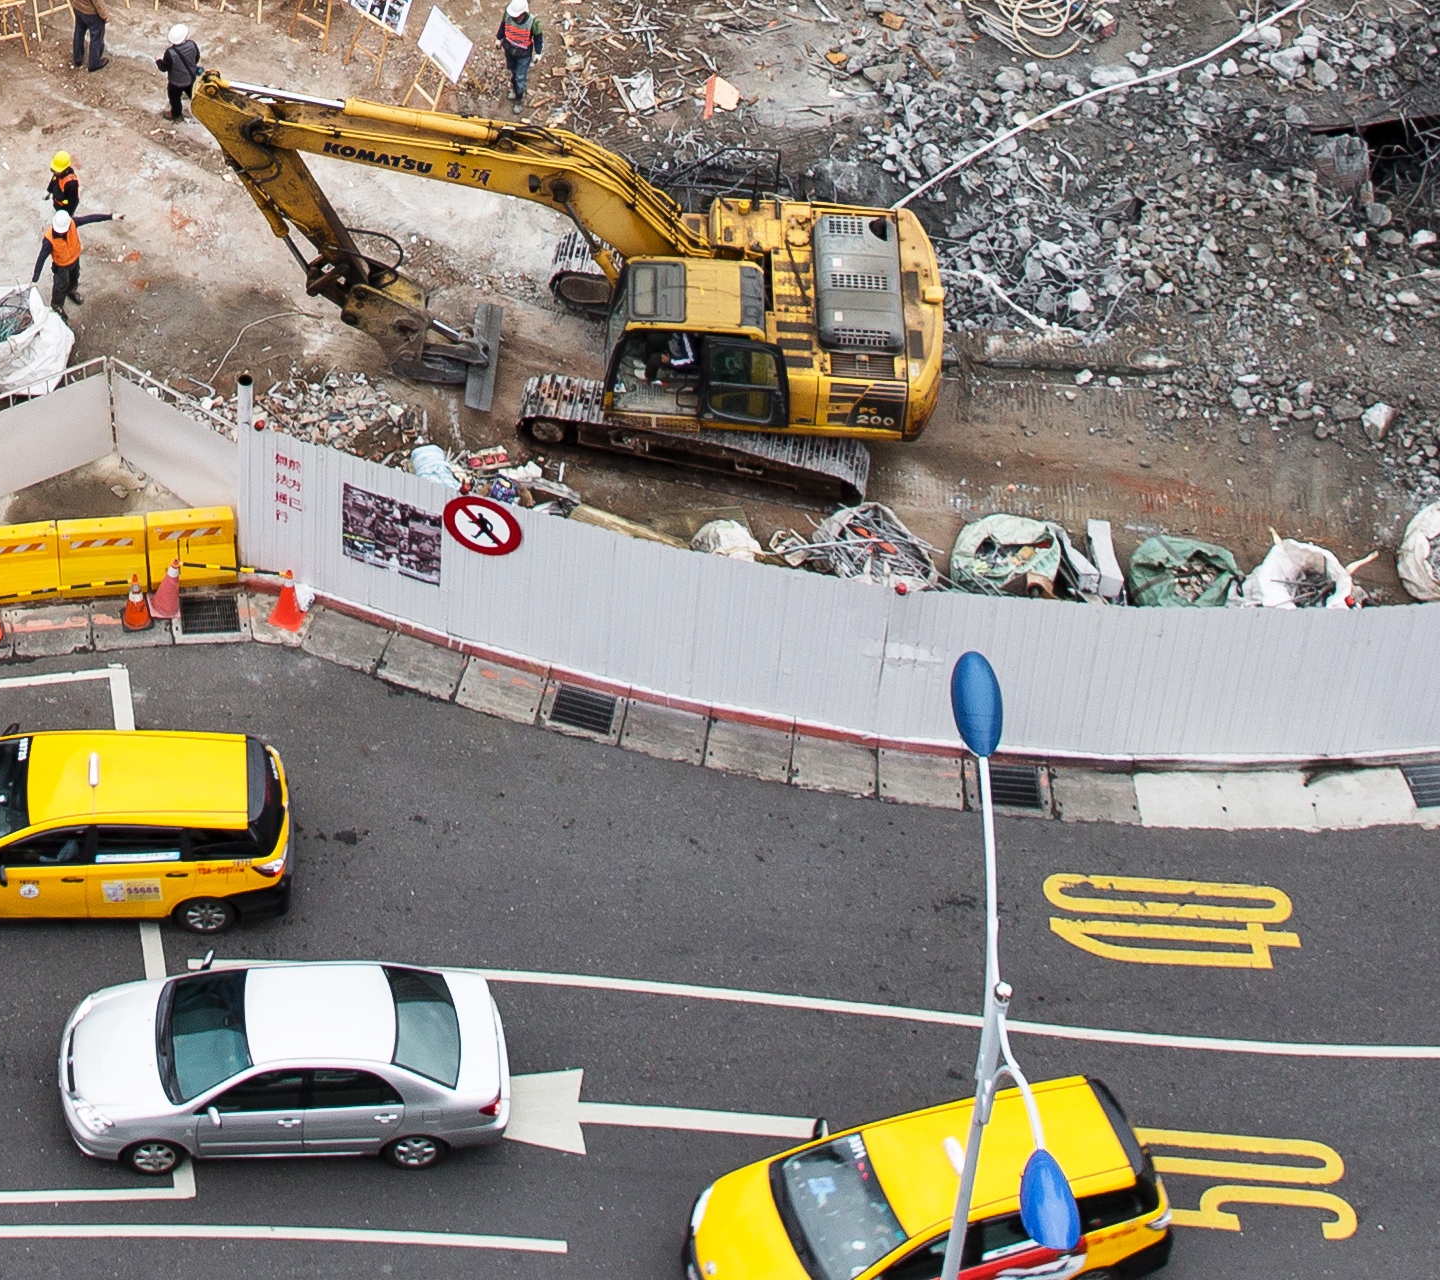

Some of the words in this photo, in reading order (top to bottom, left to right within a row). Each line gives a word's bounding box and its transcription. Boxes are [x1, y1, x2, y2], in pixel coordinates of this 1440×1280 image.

[322, 141, 433, 174] KOMATSU
[856, 414, 895, 426] 200
[1042, 872, 1302, 969] 40
[1131, 1127, 1358, 1241] 50
